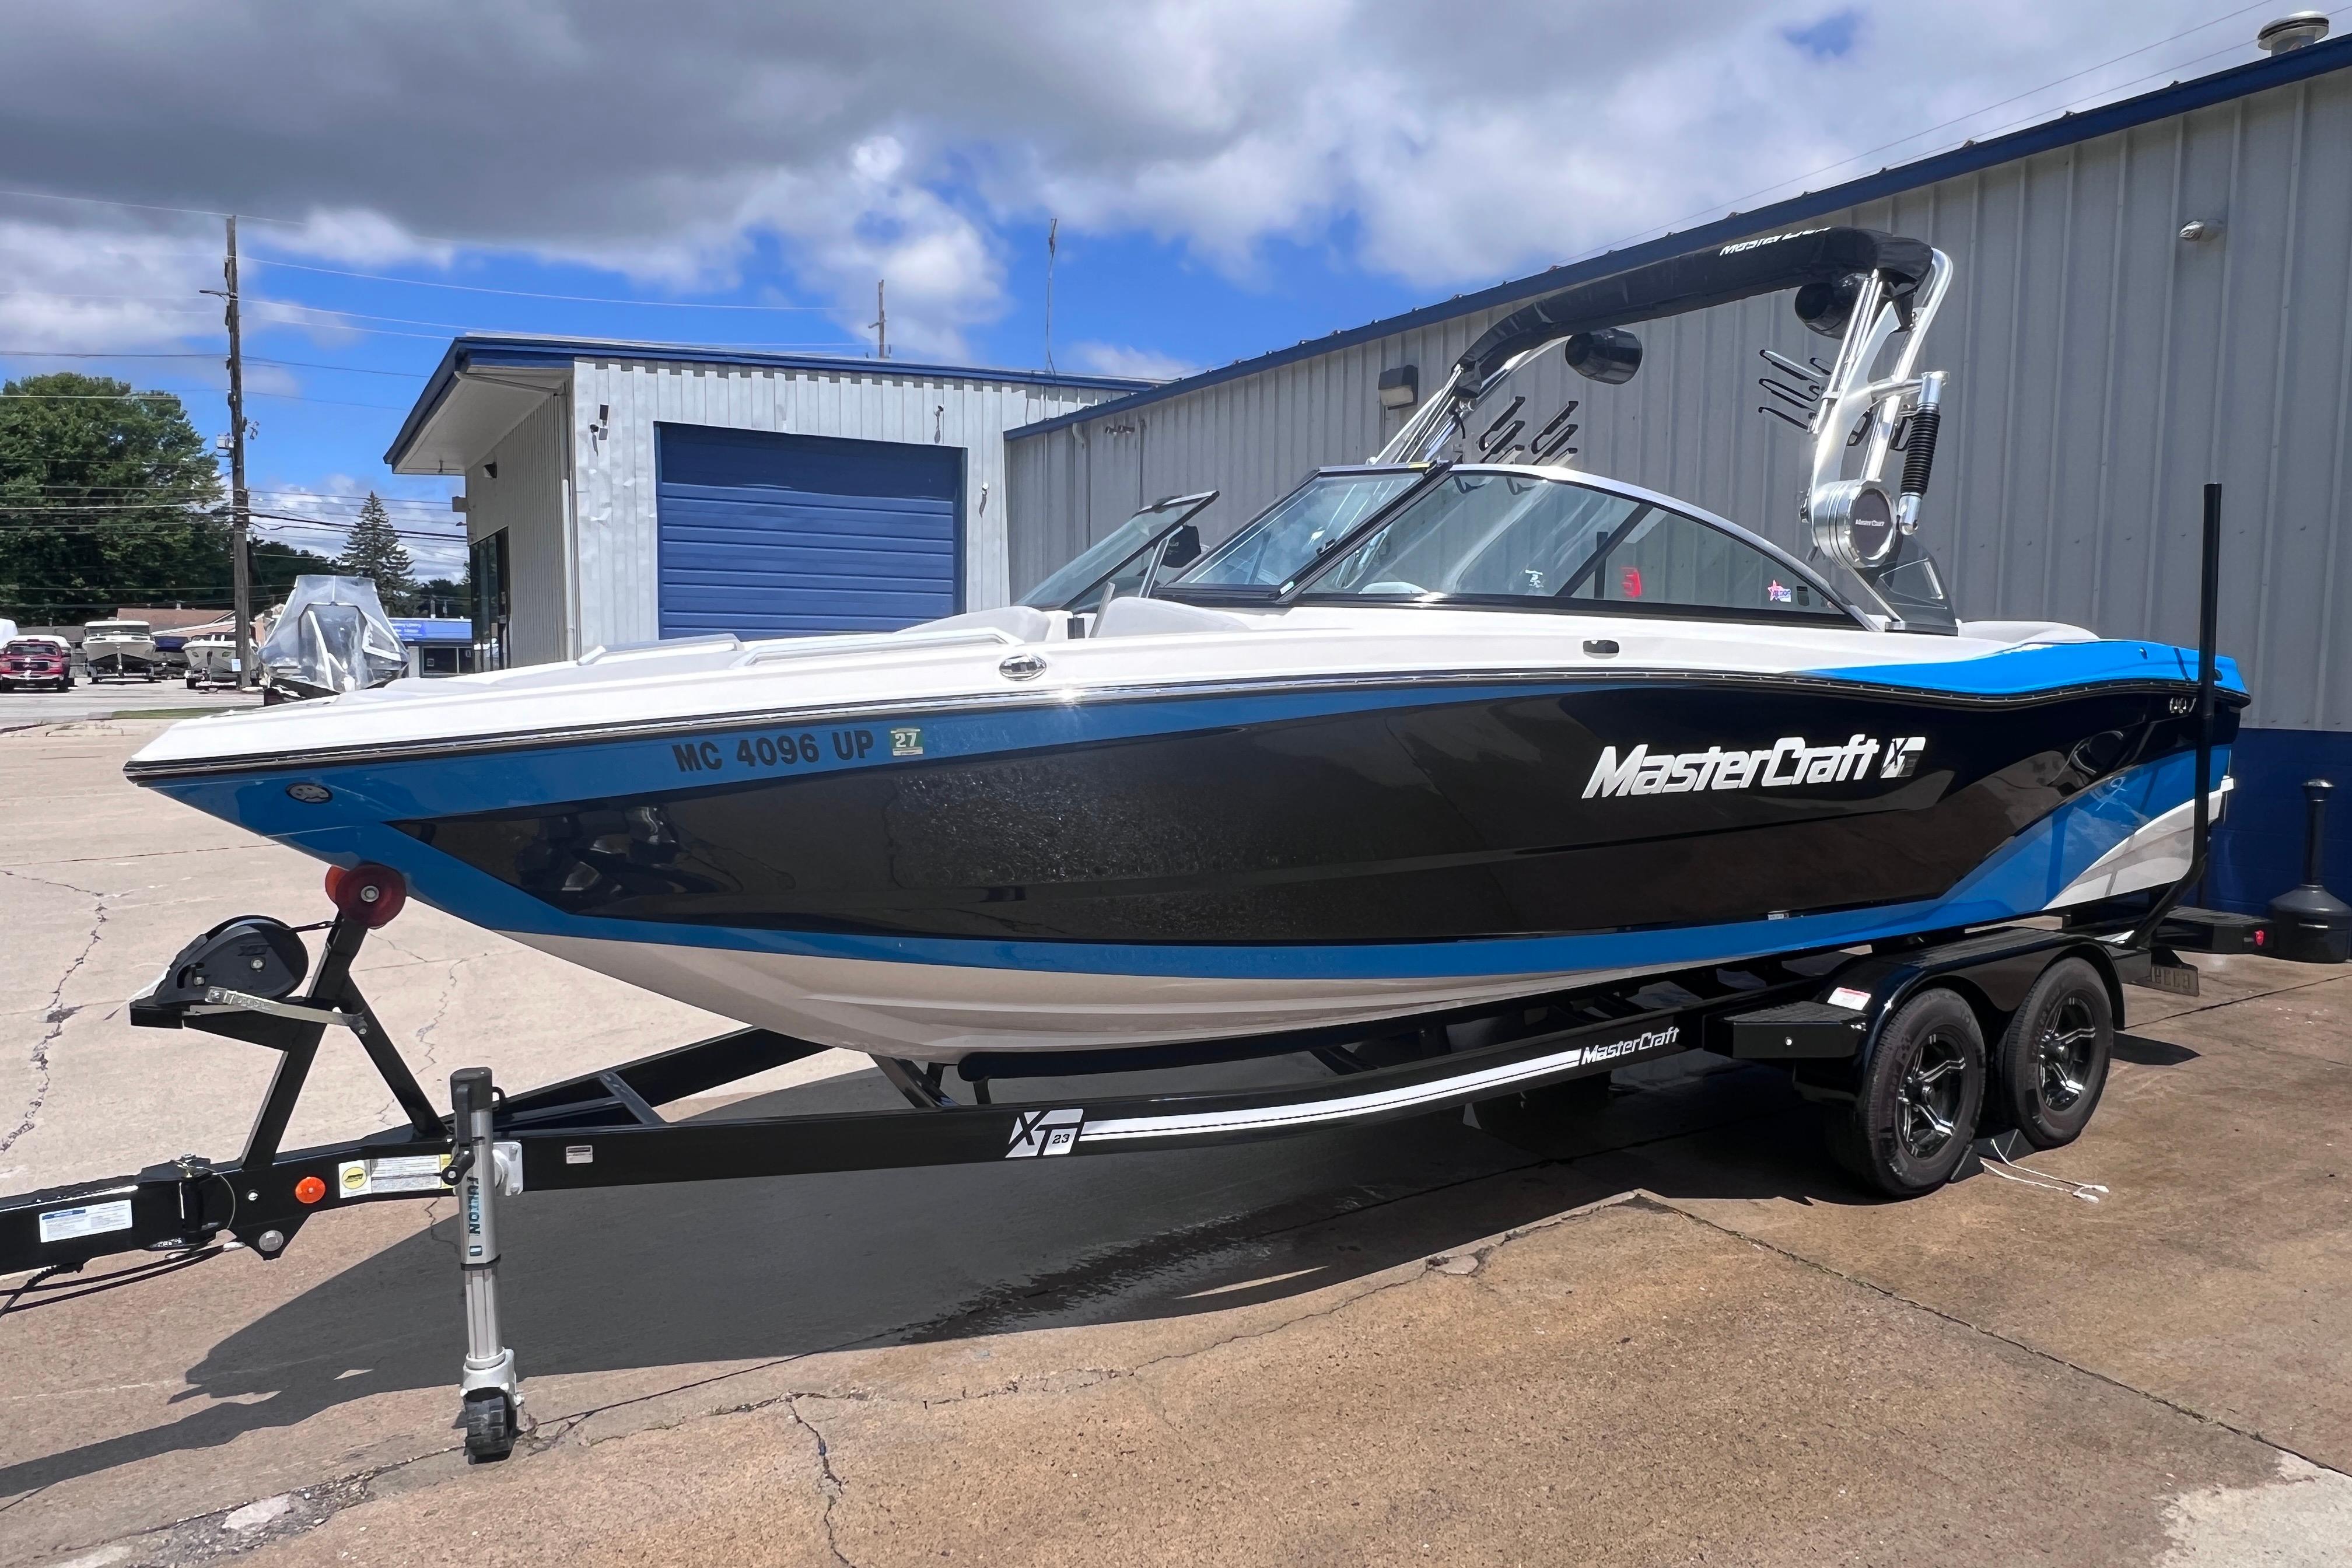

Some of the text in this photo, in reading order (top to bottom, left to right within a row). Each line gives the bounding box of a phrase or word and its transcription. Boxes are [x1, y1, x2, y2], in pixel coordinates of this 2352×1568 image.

[671, 730, 874, 772] MC 4096 UP
[895, 732, 916, 748] 27
[1581, 734, 1879, 799] MasterCraft
[1581, 1026, 1679, 1065] MasterCraft
[1005, 1109, 1084, 1158] XT 23
[467, 1177, 481, 1234] FULTON
